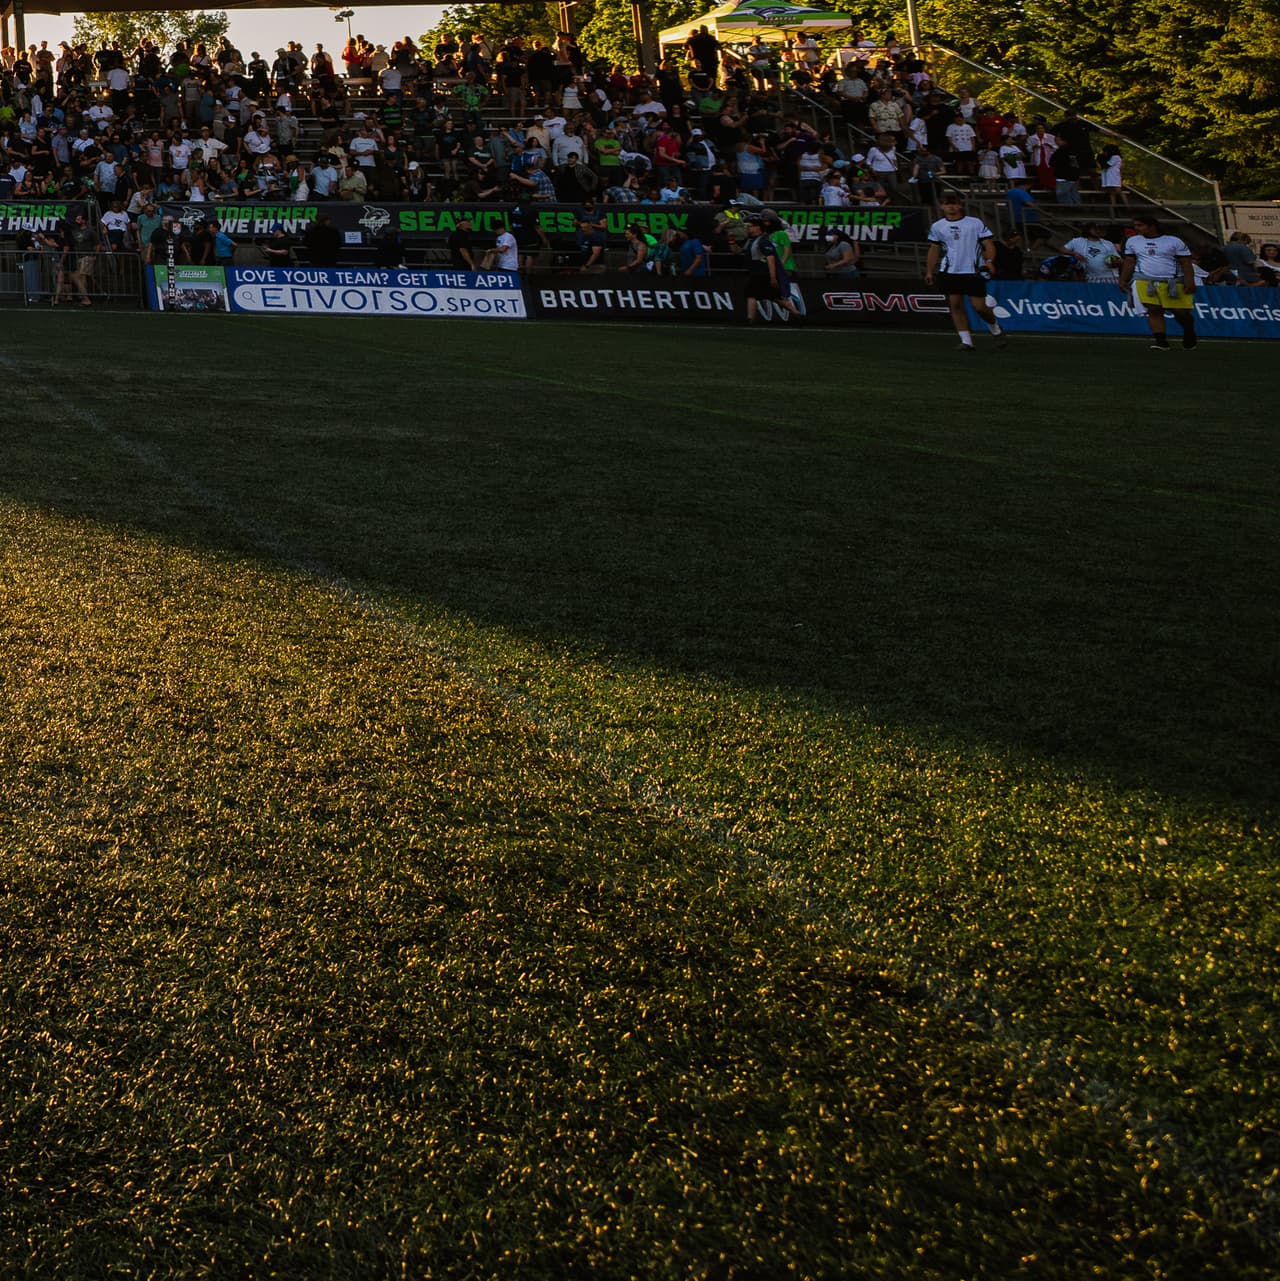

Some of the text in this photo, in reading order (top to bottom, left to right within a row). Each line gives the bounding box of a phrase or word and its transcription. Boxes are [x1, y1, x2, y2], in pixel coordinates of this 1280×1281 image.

[215, 206, 319, 224] TOGETHER
[778, 210, 903, 228] TOGETHER
[217, 219, 250, 234] WE
[235, 270, 515, 288] LOVE YOUR TEAM? GET THE APP!
[542, 289, 735, 311] BROTHERTON
[822, 291, 951, 313] GMC
[1007, 297, 1104, 319] Virginia
